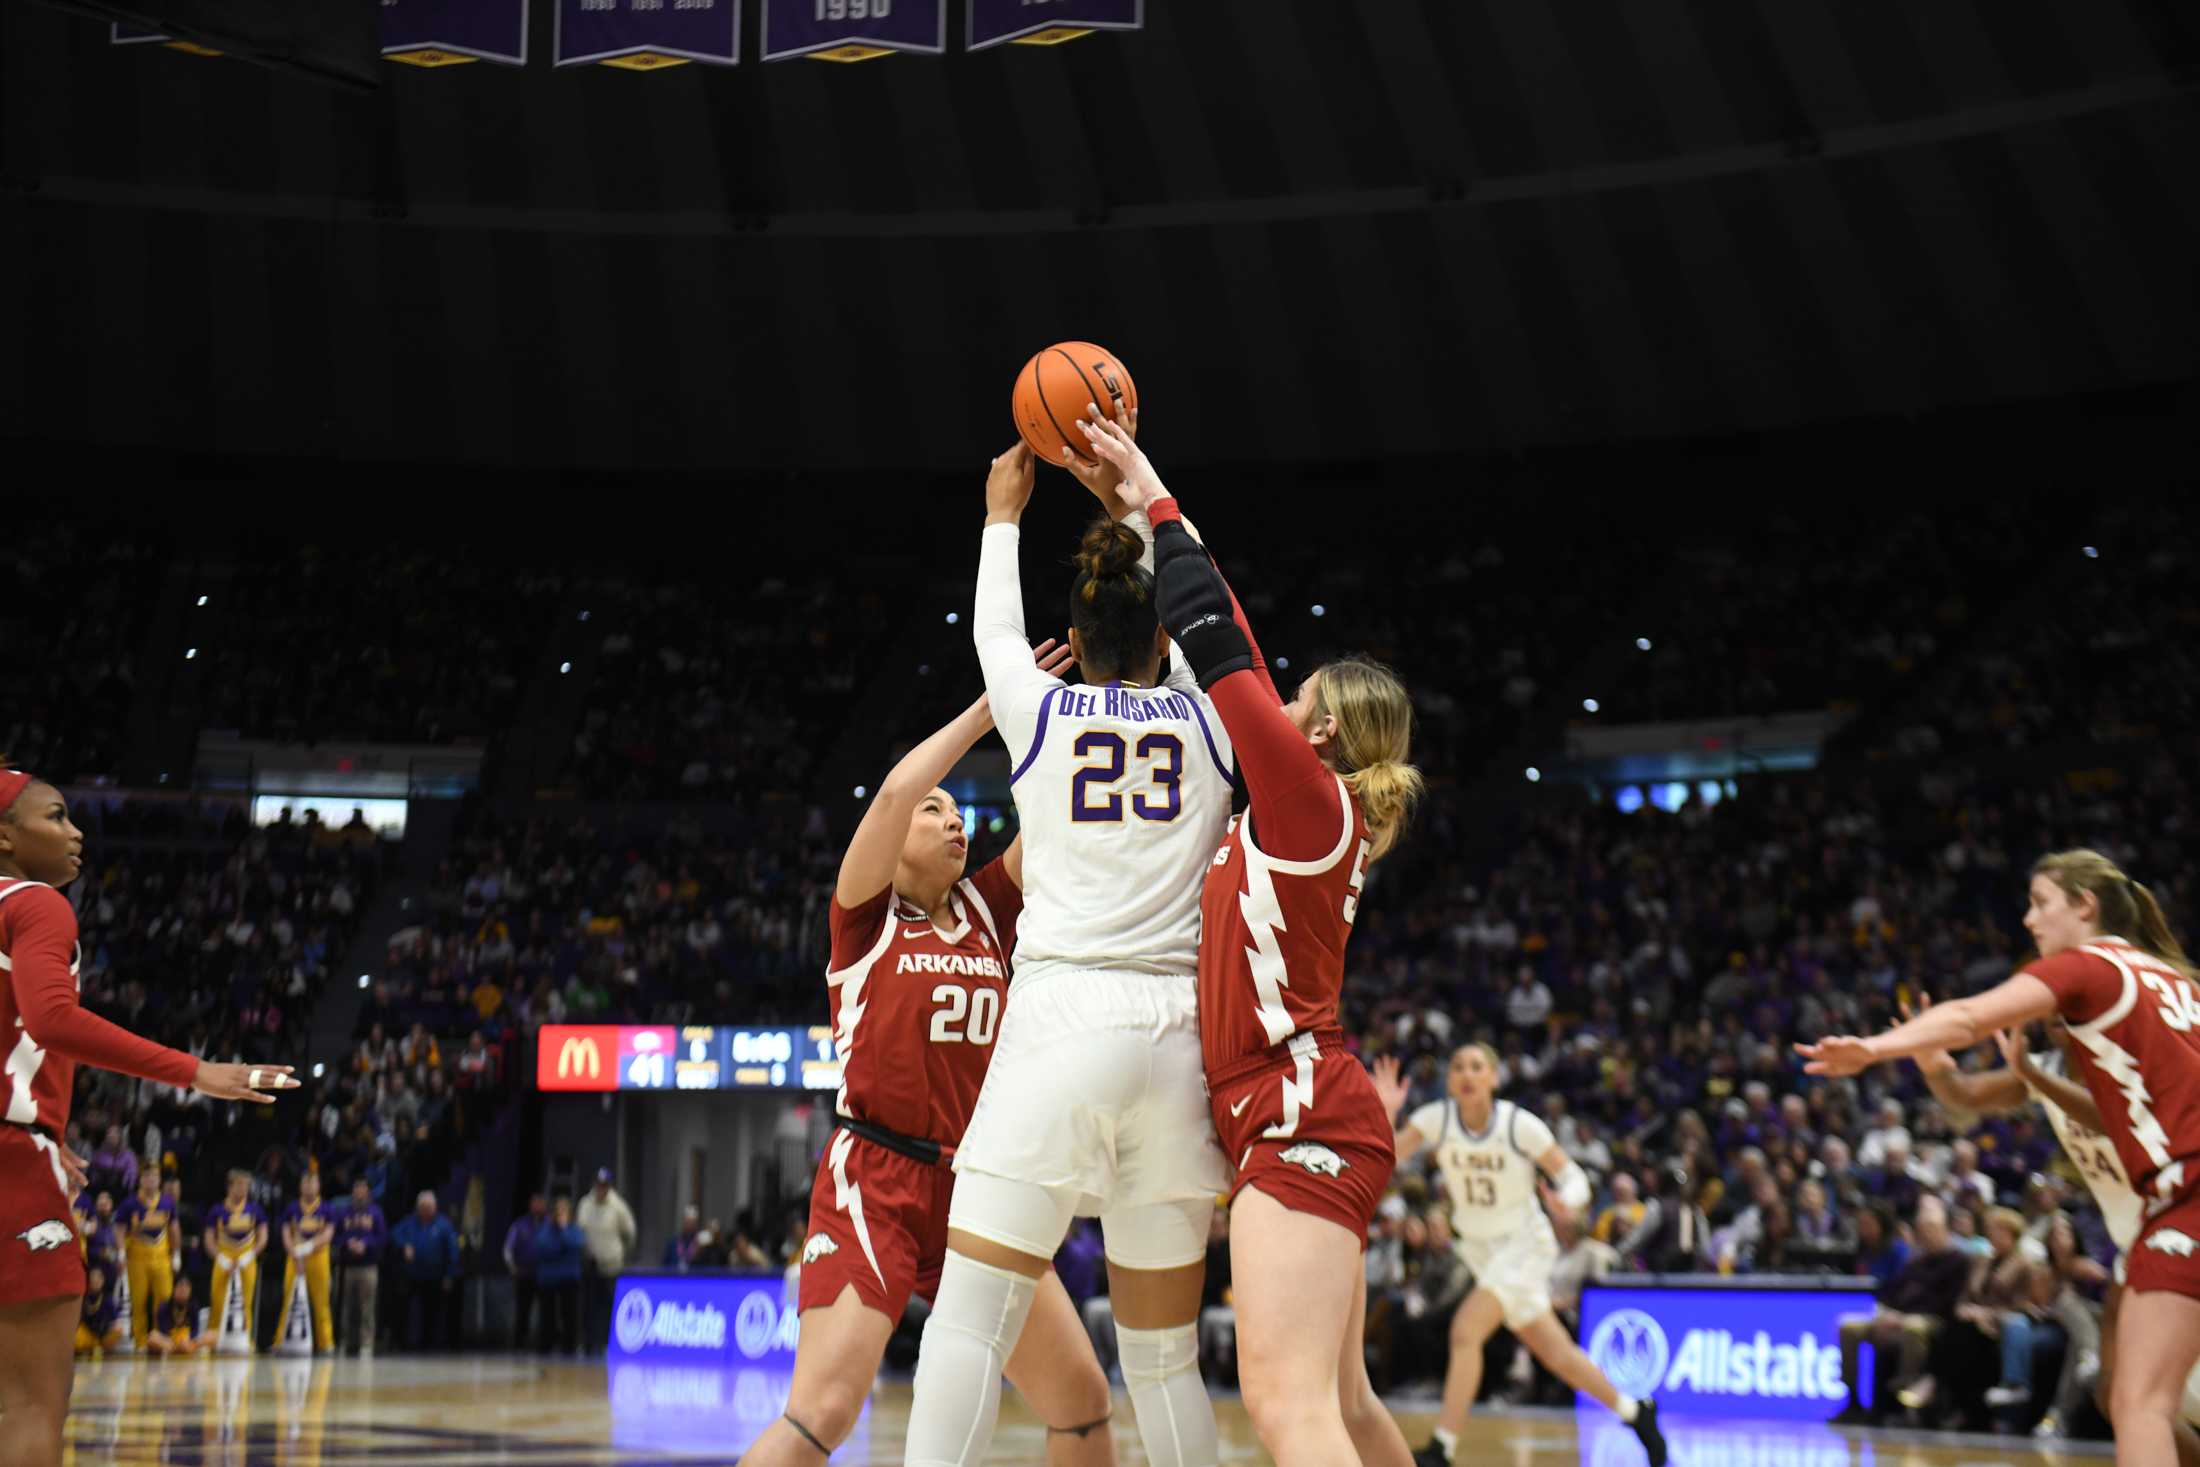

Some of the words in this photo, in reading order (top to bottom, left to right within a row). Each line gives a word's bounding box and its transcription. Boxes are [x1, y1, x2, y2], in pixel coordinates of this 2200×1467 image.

[1058, 689, 1097, 717] DEL
[1104, 688, 1190, 722] ROSARIO
[1072, 730, 1183, 824] 23
[930, 984, 999, 1046] 20
[628, 1052, 664, 1088] 41
[1463, 1176, 1497, 1207] 13
[1665, 1329, 1849, 1401] Allstate
